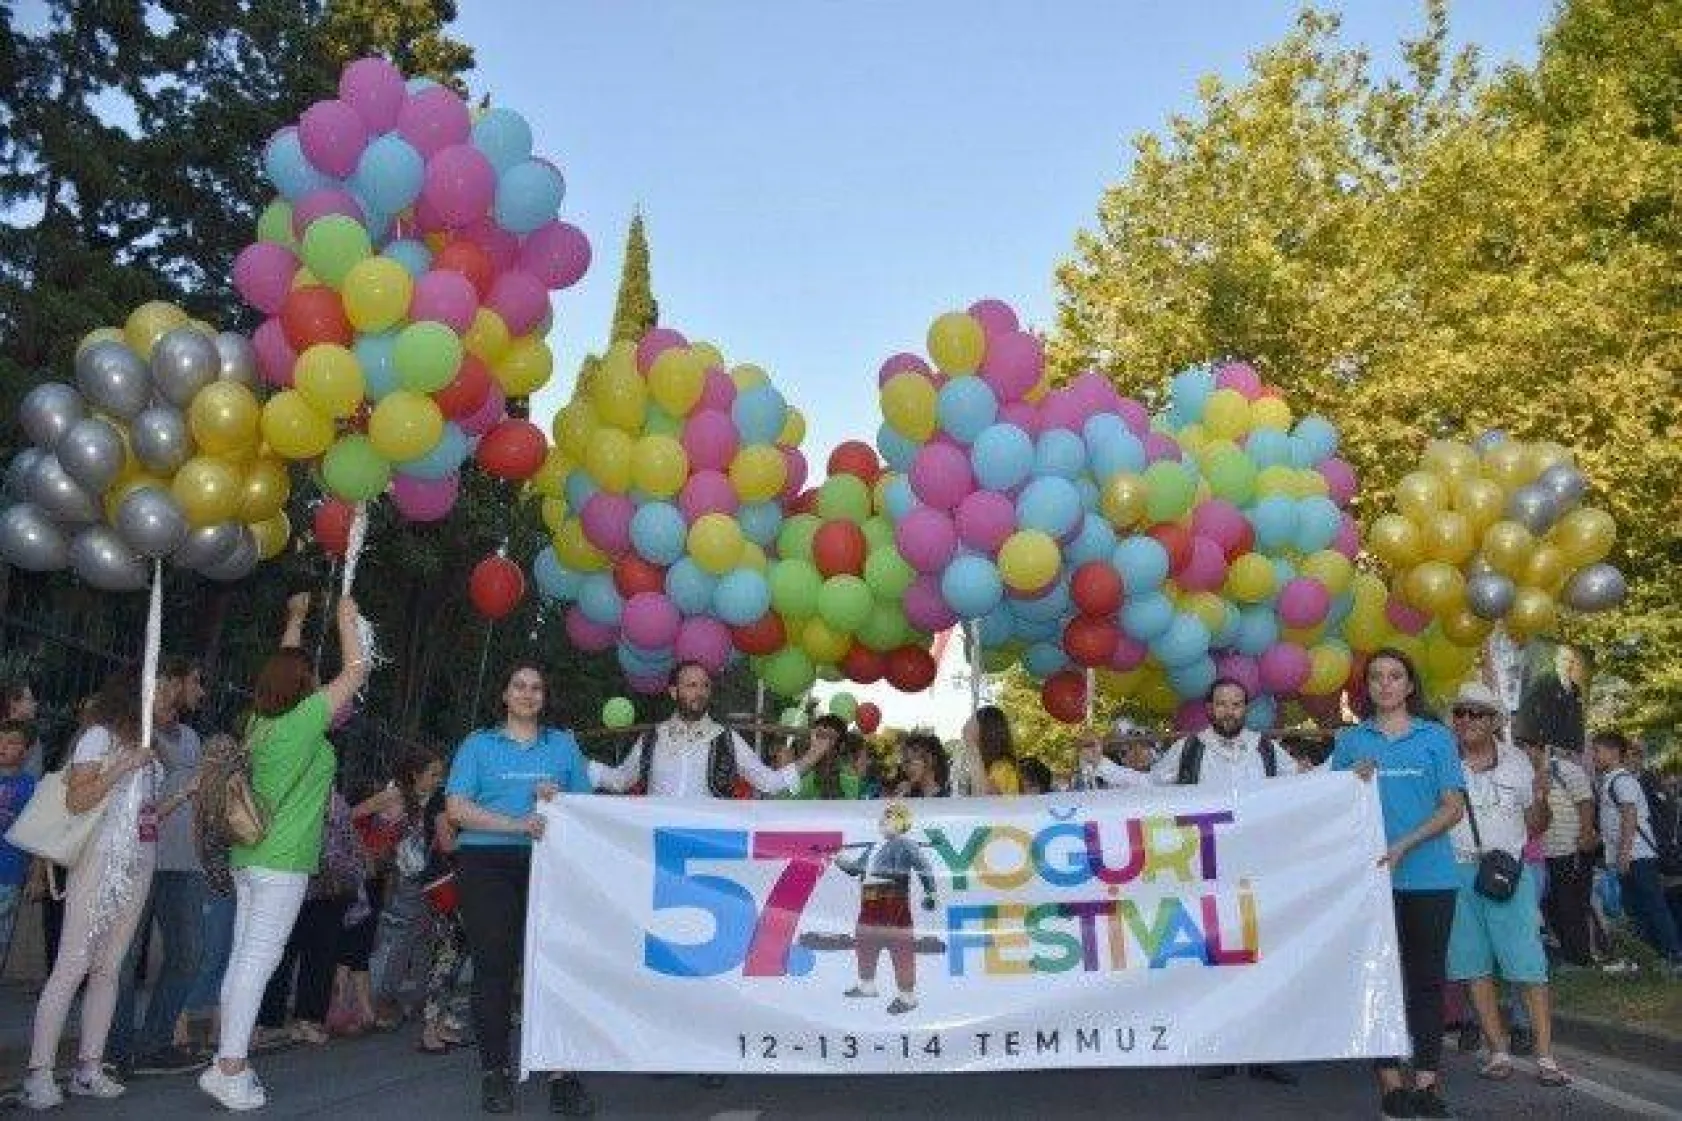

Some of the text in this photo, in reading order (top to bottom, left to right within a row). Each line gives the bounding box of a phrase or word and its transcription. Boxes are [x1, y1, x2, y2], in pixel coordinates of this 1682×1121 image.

[923, 806, 1234, 890] YOĞURT
[947, 877, 1262, 976] FESTİVALİ
[738, 1026, 1169, 1059] 12-13-14 TEMMUZ
